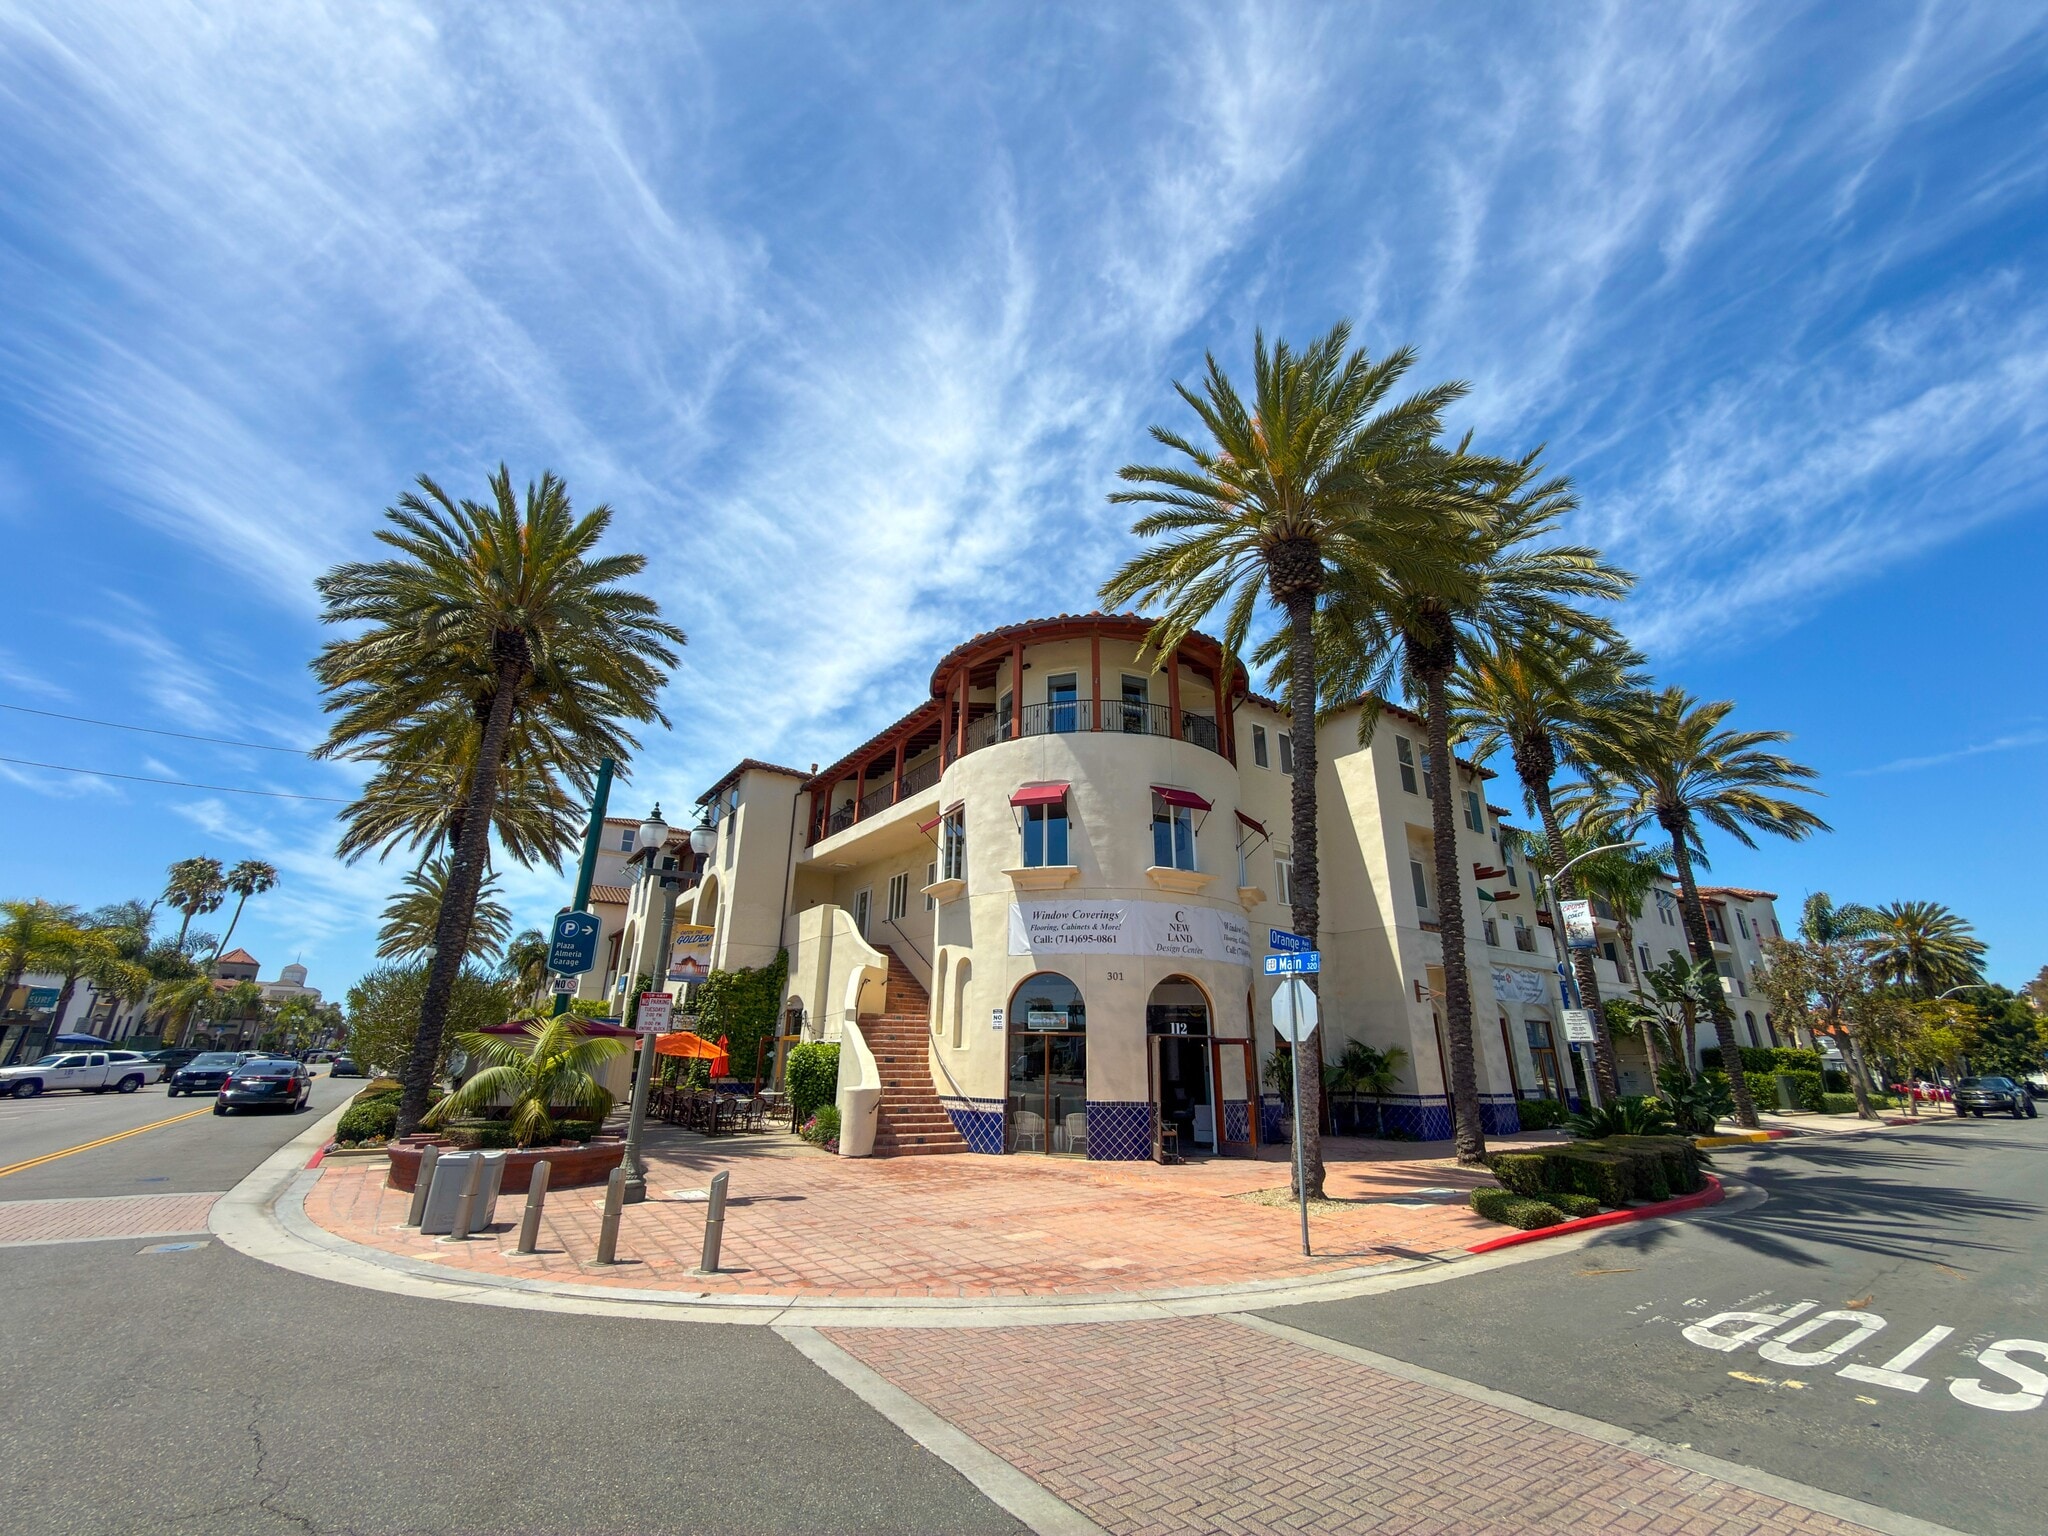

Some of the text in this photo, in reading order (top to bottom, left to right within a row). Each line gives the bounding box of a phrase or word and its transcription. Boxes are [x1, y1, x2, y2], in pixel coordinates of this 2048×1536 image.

[1032, 909, 1119, 921] Window Coverings
[1175, 911, 1184, 922] C
[1030, 924, 1059, 932] Flooring,
[1100, 923, 1121, 931] More!
[1169, 923, 1190, 932] NEW
[677, 934, 712, 944] GOLDEN
[1033, 934, 1117, 945] Call: (714)695-0861
[1167, 933, 1193, 943] LAND
[1271, 931, 1299, 952] Orange
[1156, 943, 1203, 954] Design Center
[554, 950, 582, 958] Almeria
[553, 958, 580, 967] Garage
[1279, 956, 1302, 970] Main
[1307, 962, 1318, 970] 320
[1107, 972, 1124, 981] 301
[555, 980, 566, 988] NO
[28, 996, 52, 1004] SURF
[1170, 1022, 1188, 1035] 112
[1681, 1301, 2048, 1411] STOP
